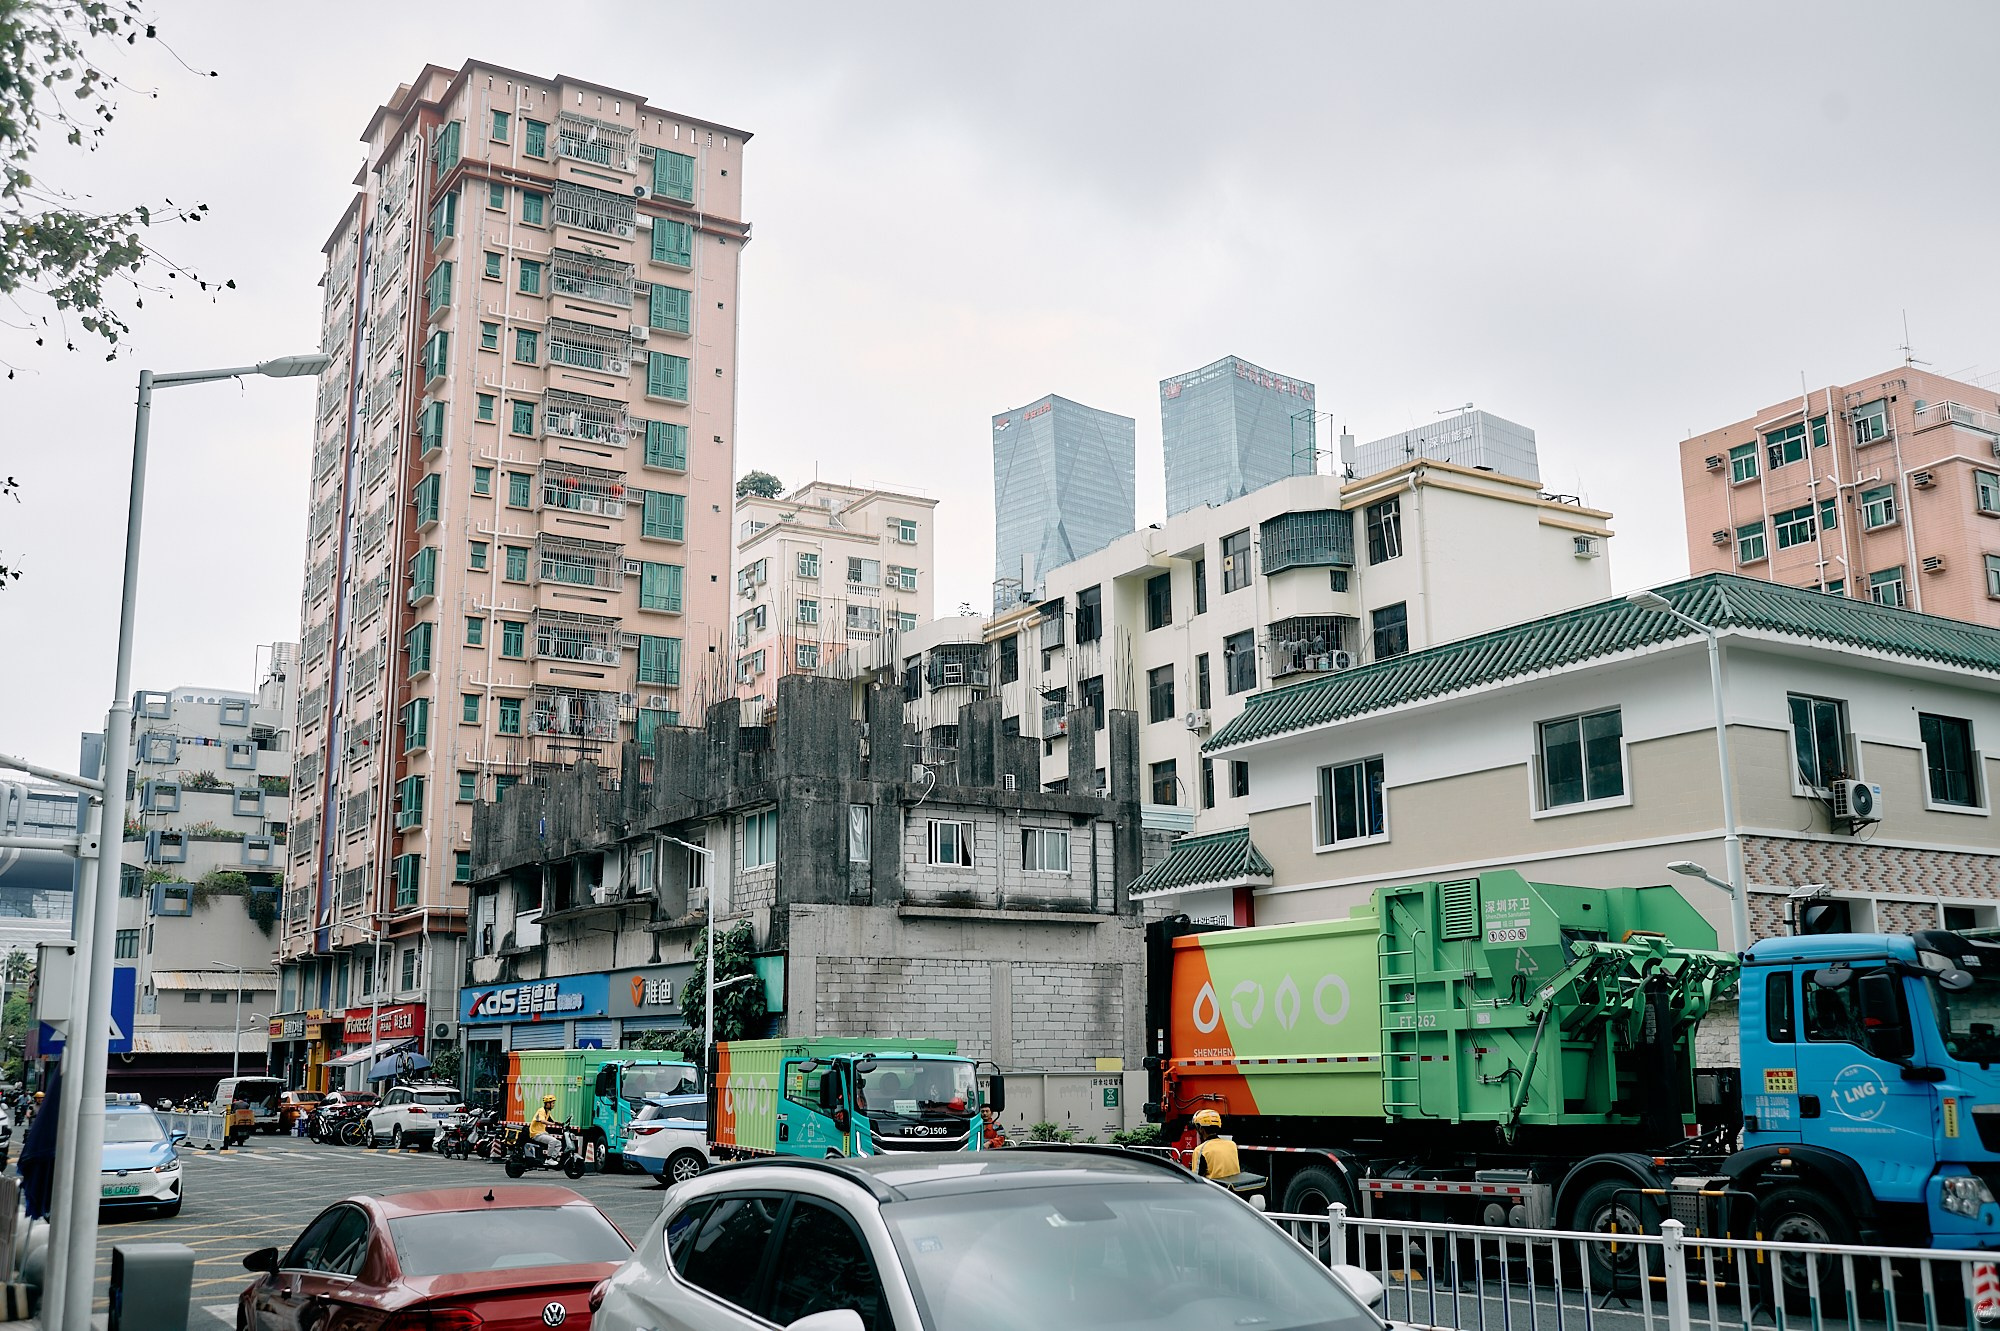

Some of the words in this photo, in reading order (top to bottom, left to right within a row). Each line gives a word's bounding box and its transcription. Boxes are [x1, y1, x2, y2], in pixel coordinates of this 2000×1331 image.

[1484, 897, 1531, 913] 深圳环卫
[644, 978, 672, 1004] 雅迪
[1400, 1014, 1436, 1028] FT-262
[1193, 1048, 1233, 1058] SHENZHEN
[1843, 1081, 1877, 1104] LNG
[904, 1127, 914, 1135] FT
[929, 1127, 948, 1135] 1506
